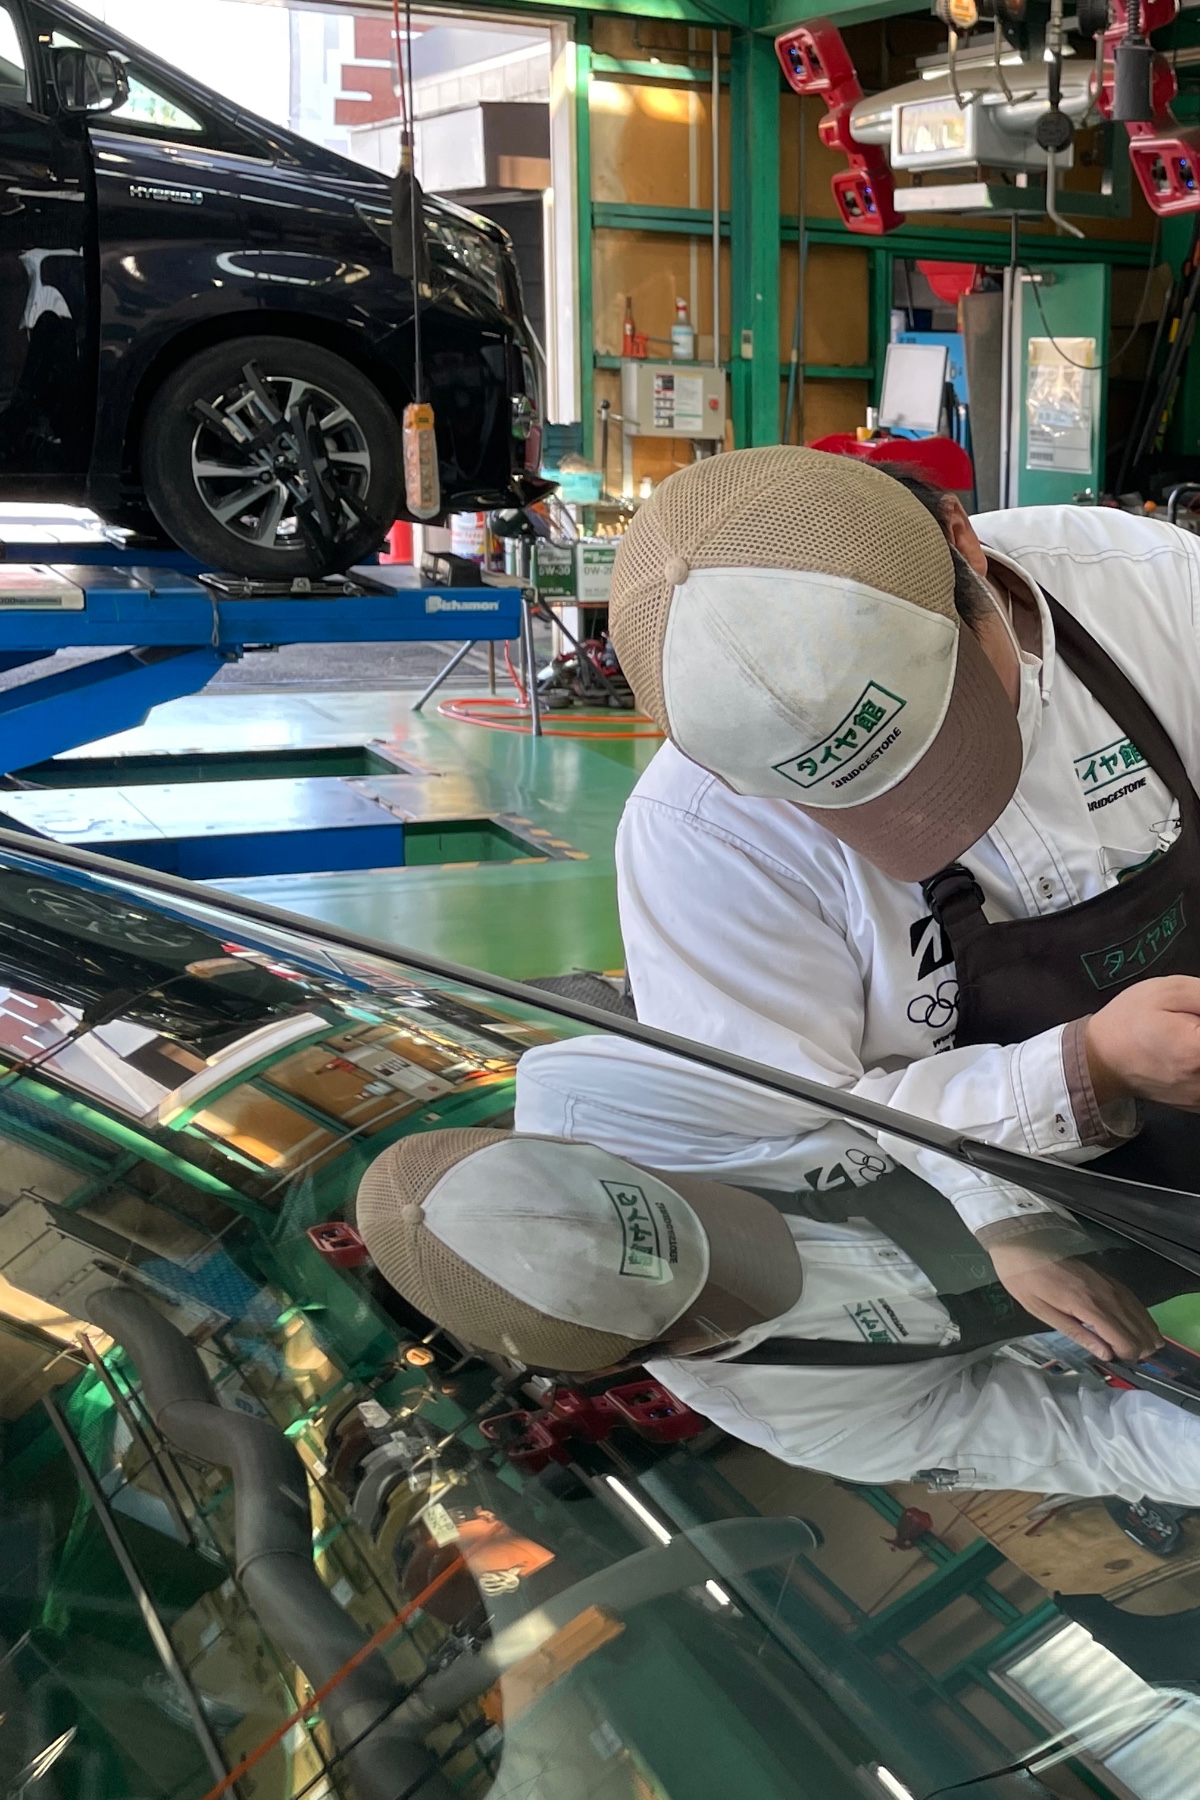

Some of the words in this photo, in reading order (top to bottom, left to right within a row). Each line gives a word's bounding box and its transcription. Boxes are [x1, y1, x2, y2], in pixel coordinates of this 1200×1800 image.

[796, 698, 887, 778] タイヤ館
[831, 726, 902, 789] BRIDGESTONE
[1075, 743, 1144, 783] イヤ館
[1103, 907, 1178, 978] タイヤ館
